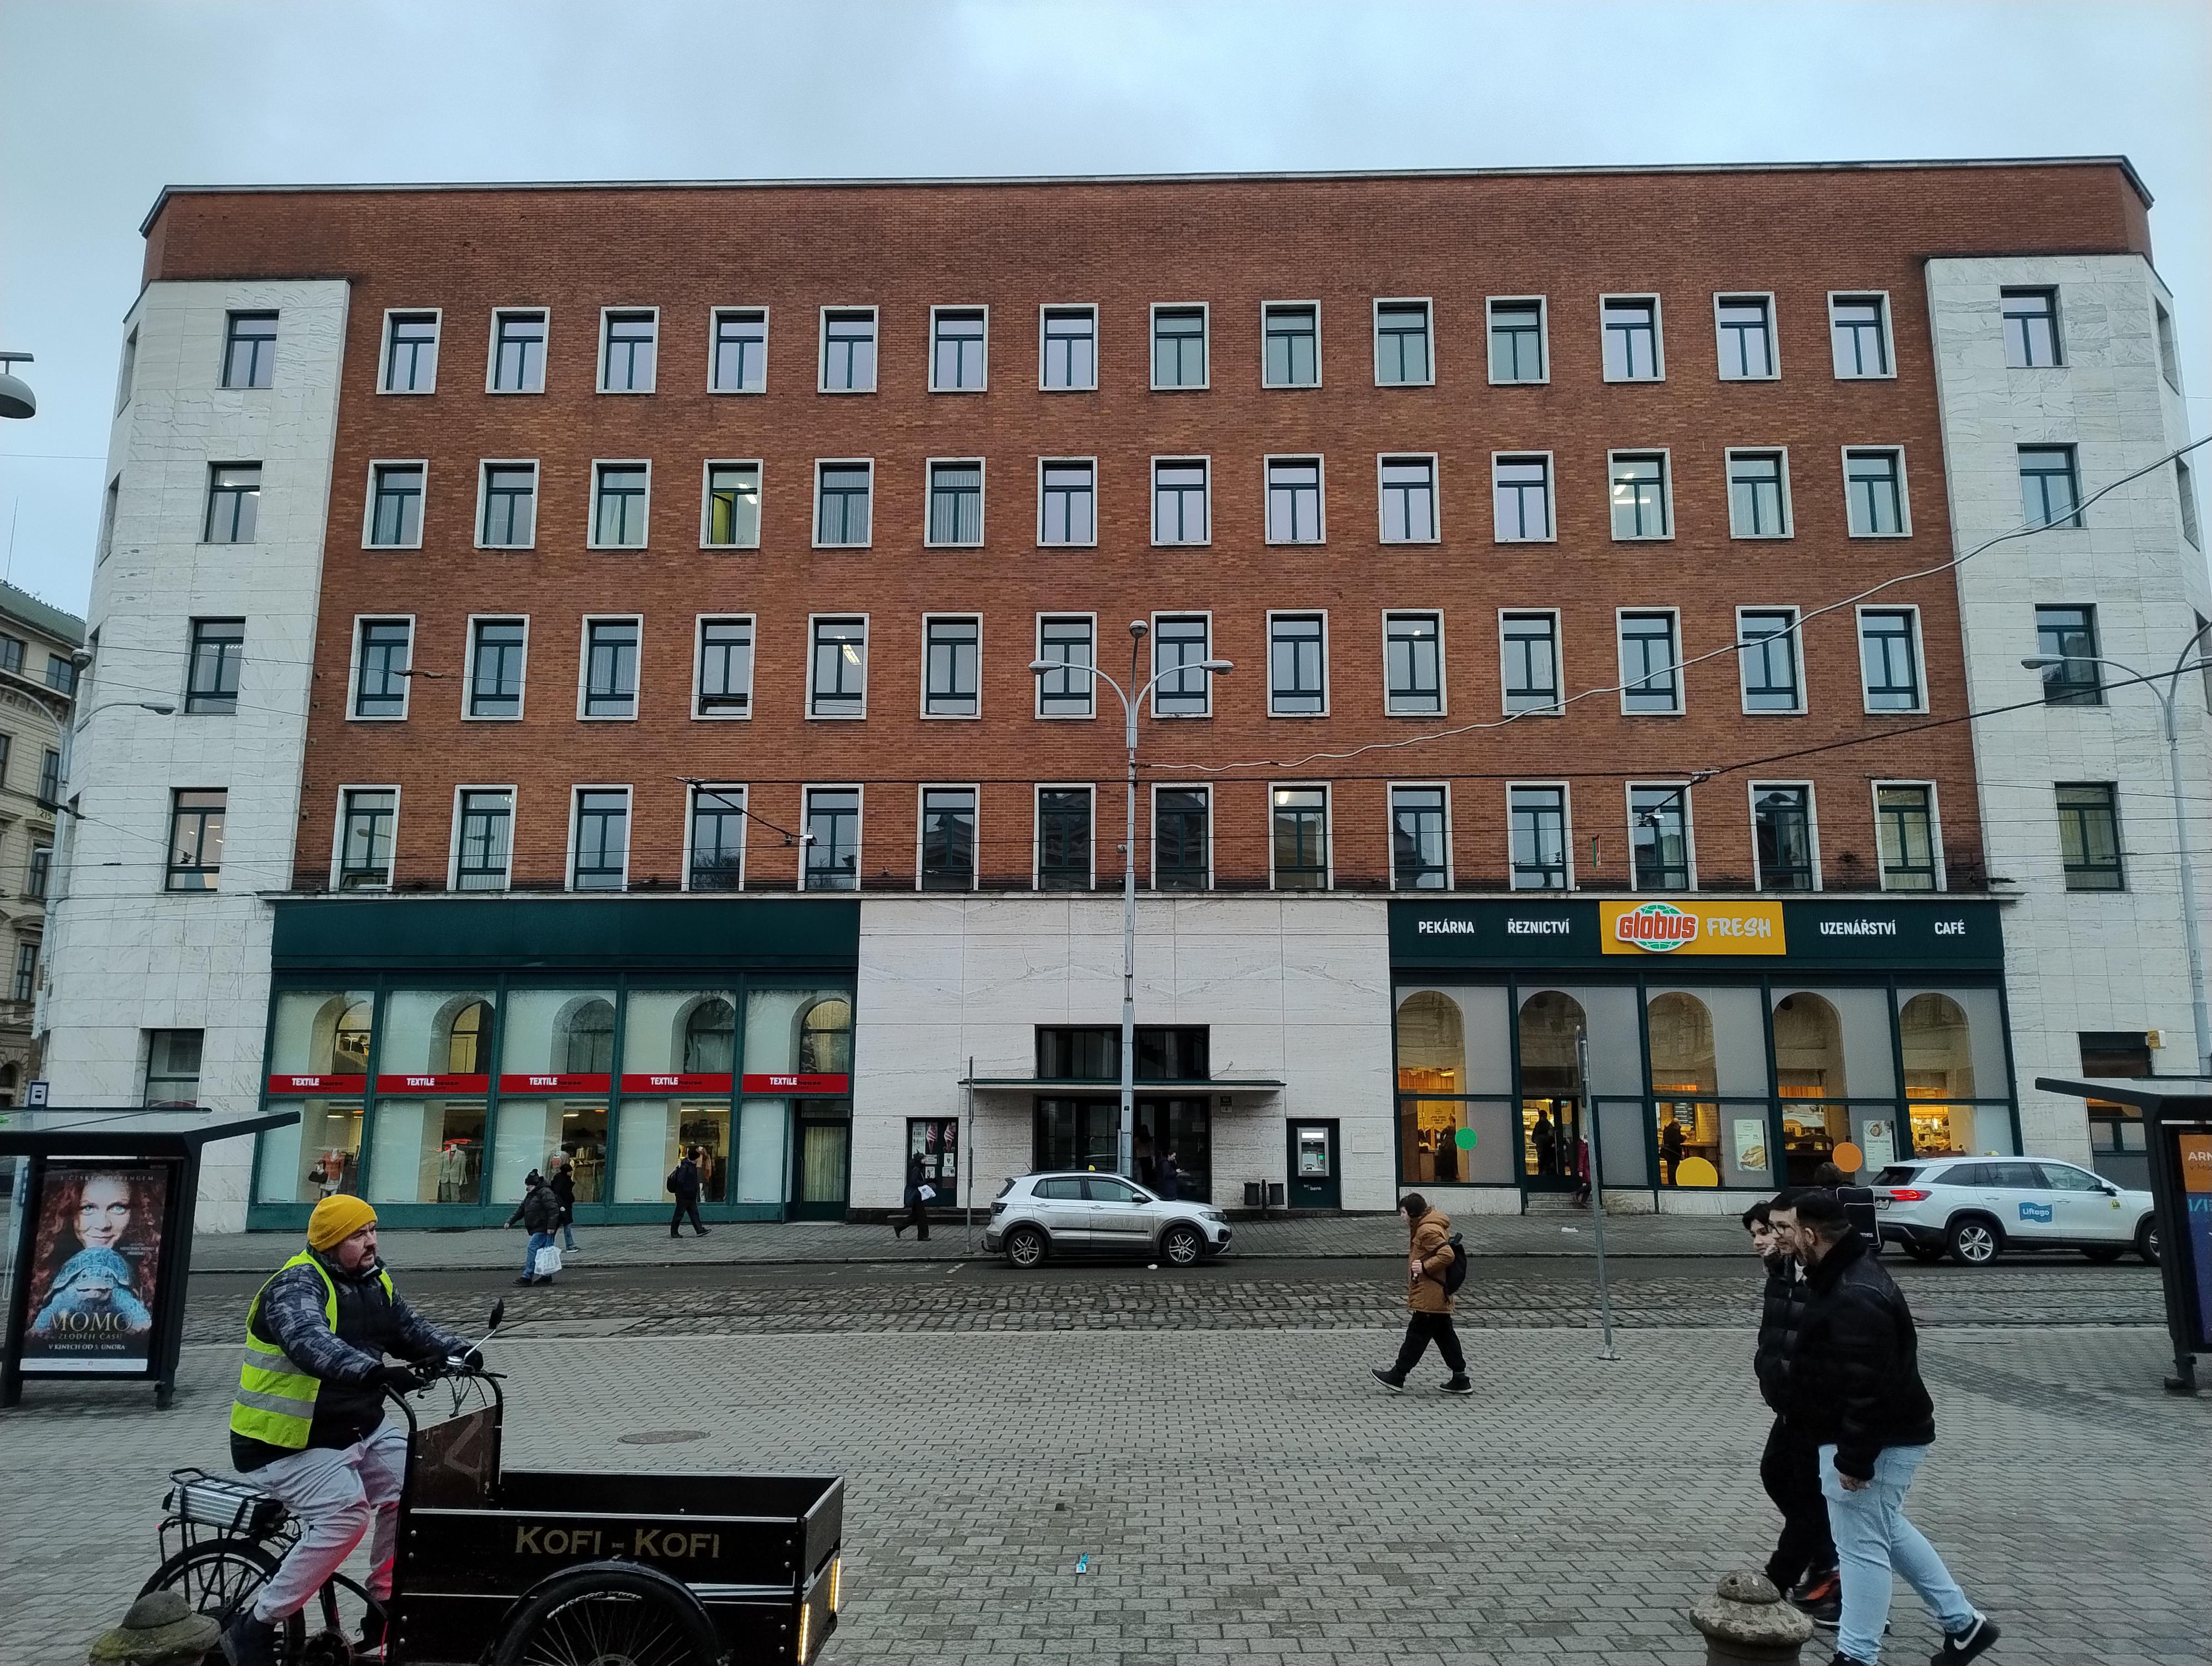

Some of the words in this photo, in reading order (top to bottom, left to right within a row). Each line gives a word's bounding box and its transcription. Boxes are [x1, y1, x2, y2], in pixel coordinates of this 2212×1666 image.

[1418, 918, 1475, 934] PEKÁRNA
[1507, 918, 1570, 934] ŘEZNICTVÍ
[1706, 917, 1772, 939] FRESH
[1819, 919, 1897, 935] UZENÁŘSTVÍ
[1934, 919, 1966, 935] CAFÉ
[291, 1078, 320, 1086] TEXTILE
[406, 1077, 435, 1086] TEXTILE
[529, 1077, 558, 1086] TEXTILE
[651, 1077, 678, 1085] TEXTILE
[770, 1077, 797, 1085] TEXTILE
[2022, 1208, 2050, 1217] Liftago
[48, 1312, 133, 1332] MOMO
[514, 1526, 602, 1555] KOFI
[633, 1528, 720, 1558] KOFI
